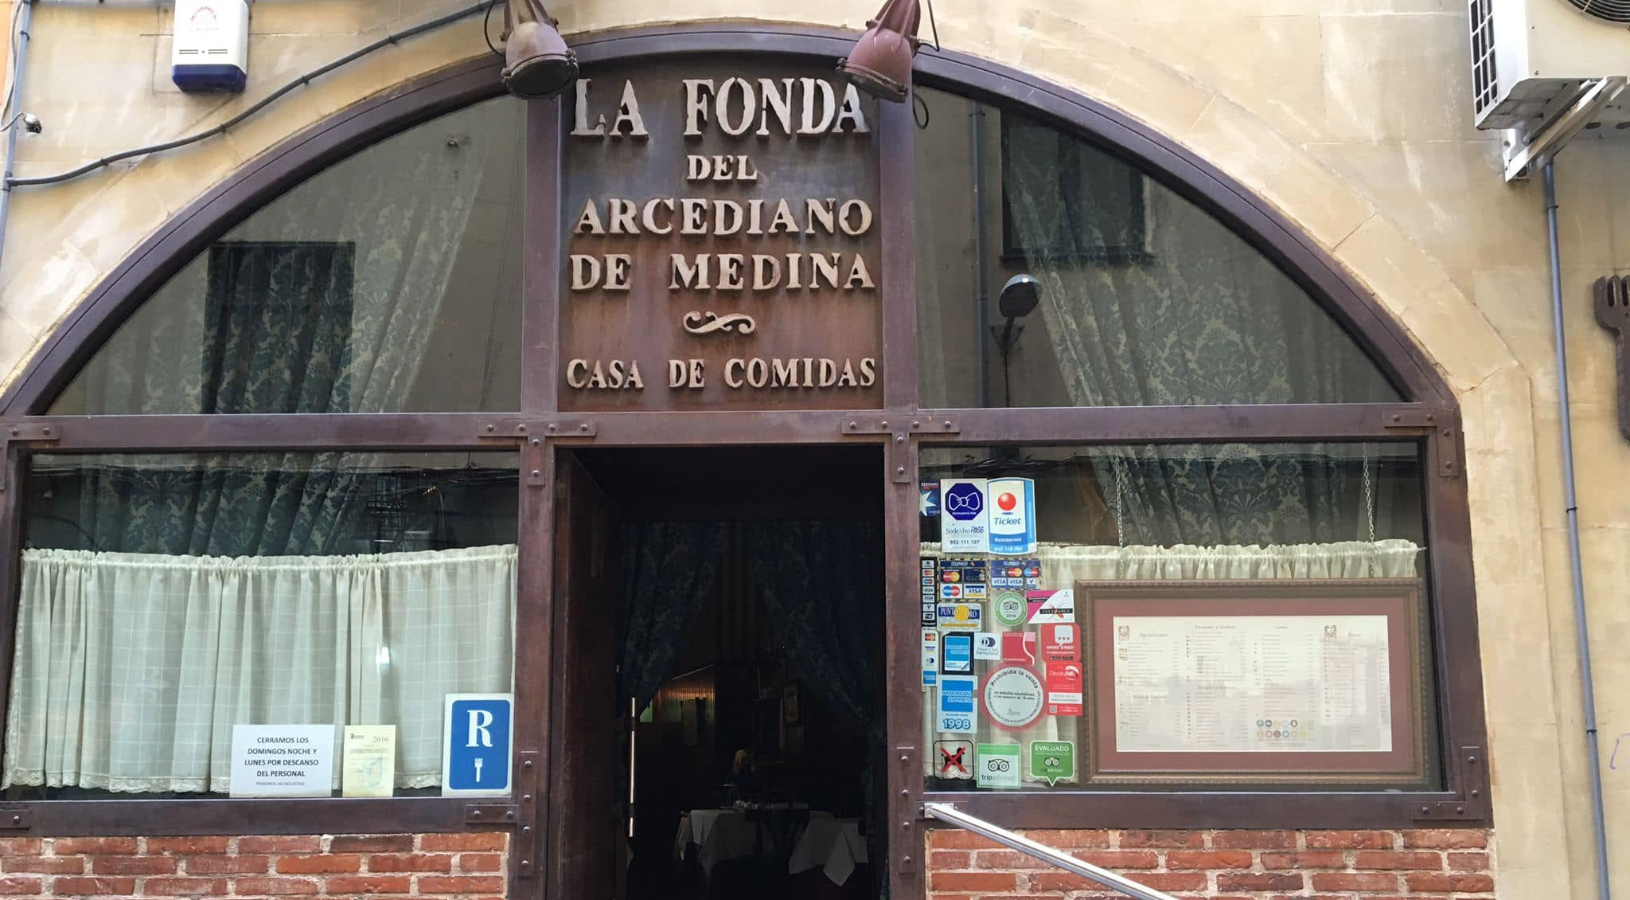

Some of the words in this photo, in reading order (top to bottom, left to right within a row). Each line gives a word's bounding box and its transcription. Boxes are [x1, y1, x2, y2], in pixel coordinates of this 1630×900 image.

[570, 78, 649, 138] LA
[682, 77, 871, 138] FONDA
[687, 155, 758, 181] DEL
[573, 197, 873, 236] ARCEDIANO
[570, 253, 632, 291] DE
[668, 252, 876, 291] MEDINA
[566, 358, 644, 389] CASA
[669, 358, 705, 388] DE
[724, 357, 876, 388] COMIDAS
[994, 517, 1022, 526] Ticket
[991, 669, 1017, 686] Prohibida
[1025, 674, 1039, 689] venta
[465, 709, 494, 747] R
[943, 718, 971, 730] 1998
